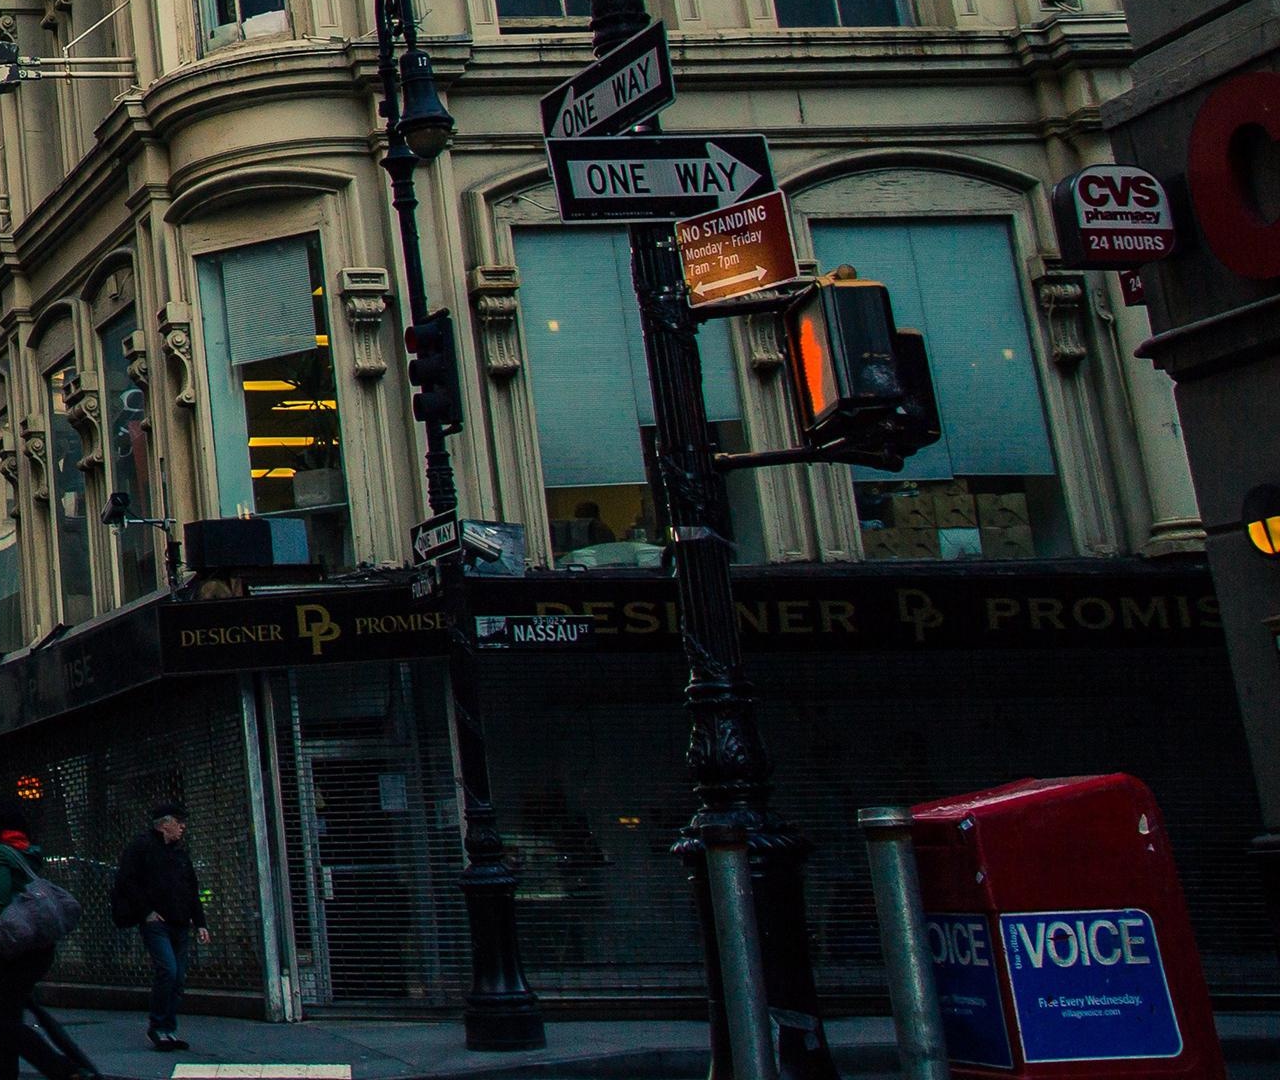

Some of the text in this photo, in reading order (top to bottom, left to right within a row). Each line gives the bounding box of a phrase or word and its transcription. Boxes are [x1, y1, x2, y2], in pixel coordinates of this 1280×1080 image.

[417, 56, 428, 67] 17
[562, 56, 651, 137] ONE WAY
[587, 161, 739, 195] ONE WAY
[1078, 174, 1160, 208] CVS
[681, 204, 768, 244] NO STANDING
[1084, 207, 1161, 224] pharmacy
[685, 241, 723, 261] Monday
[731, 229, 762, 248] Friday
[1090, 234, 1166, 251] 24 HOURS
[688, 261, 711, 277] 7am
[717, 252, 740, 270] 7pm
[417, 524, 453, 552] ONE WAY
[354, 611, 448, 636] PROMISE
[535, 600, 861, 633] ESINER
[985, 594, 1221, 633] PROMIS
[179, 623, 284, 648] DESIGNER
[513, 623, 590, 643] NASSAU ST
[927, 922, 990, 967] OICE
[1015, 918, 1152, 969] VOICE
[1014, 954, 1023, 970] the
[1038, 993, 1143, 1009] Free Every Wednesday.
